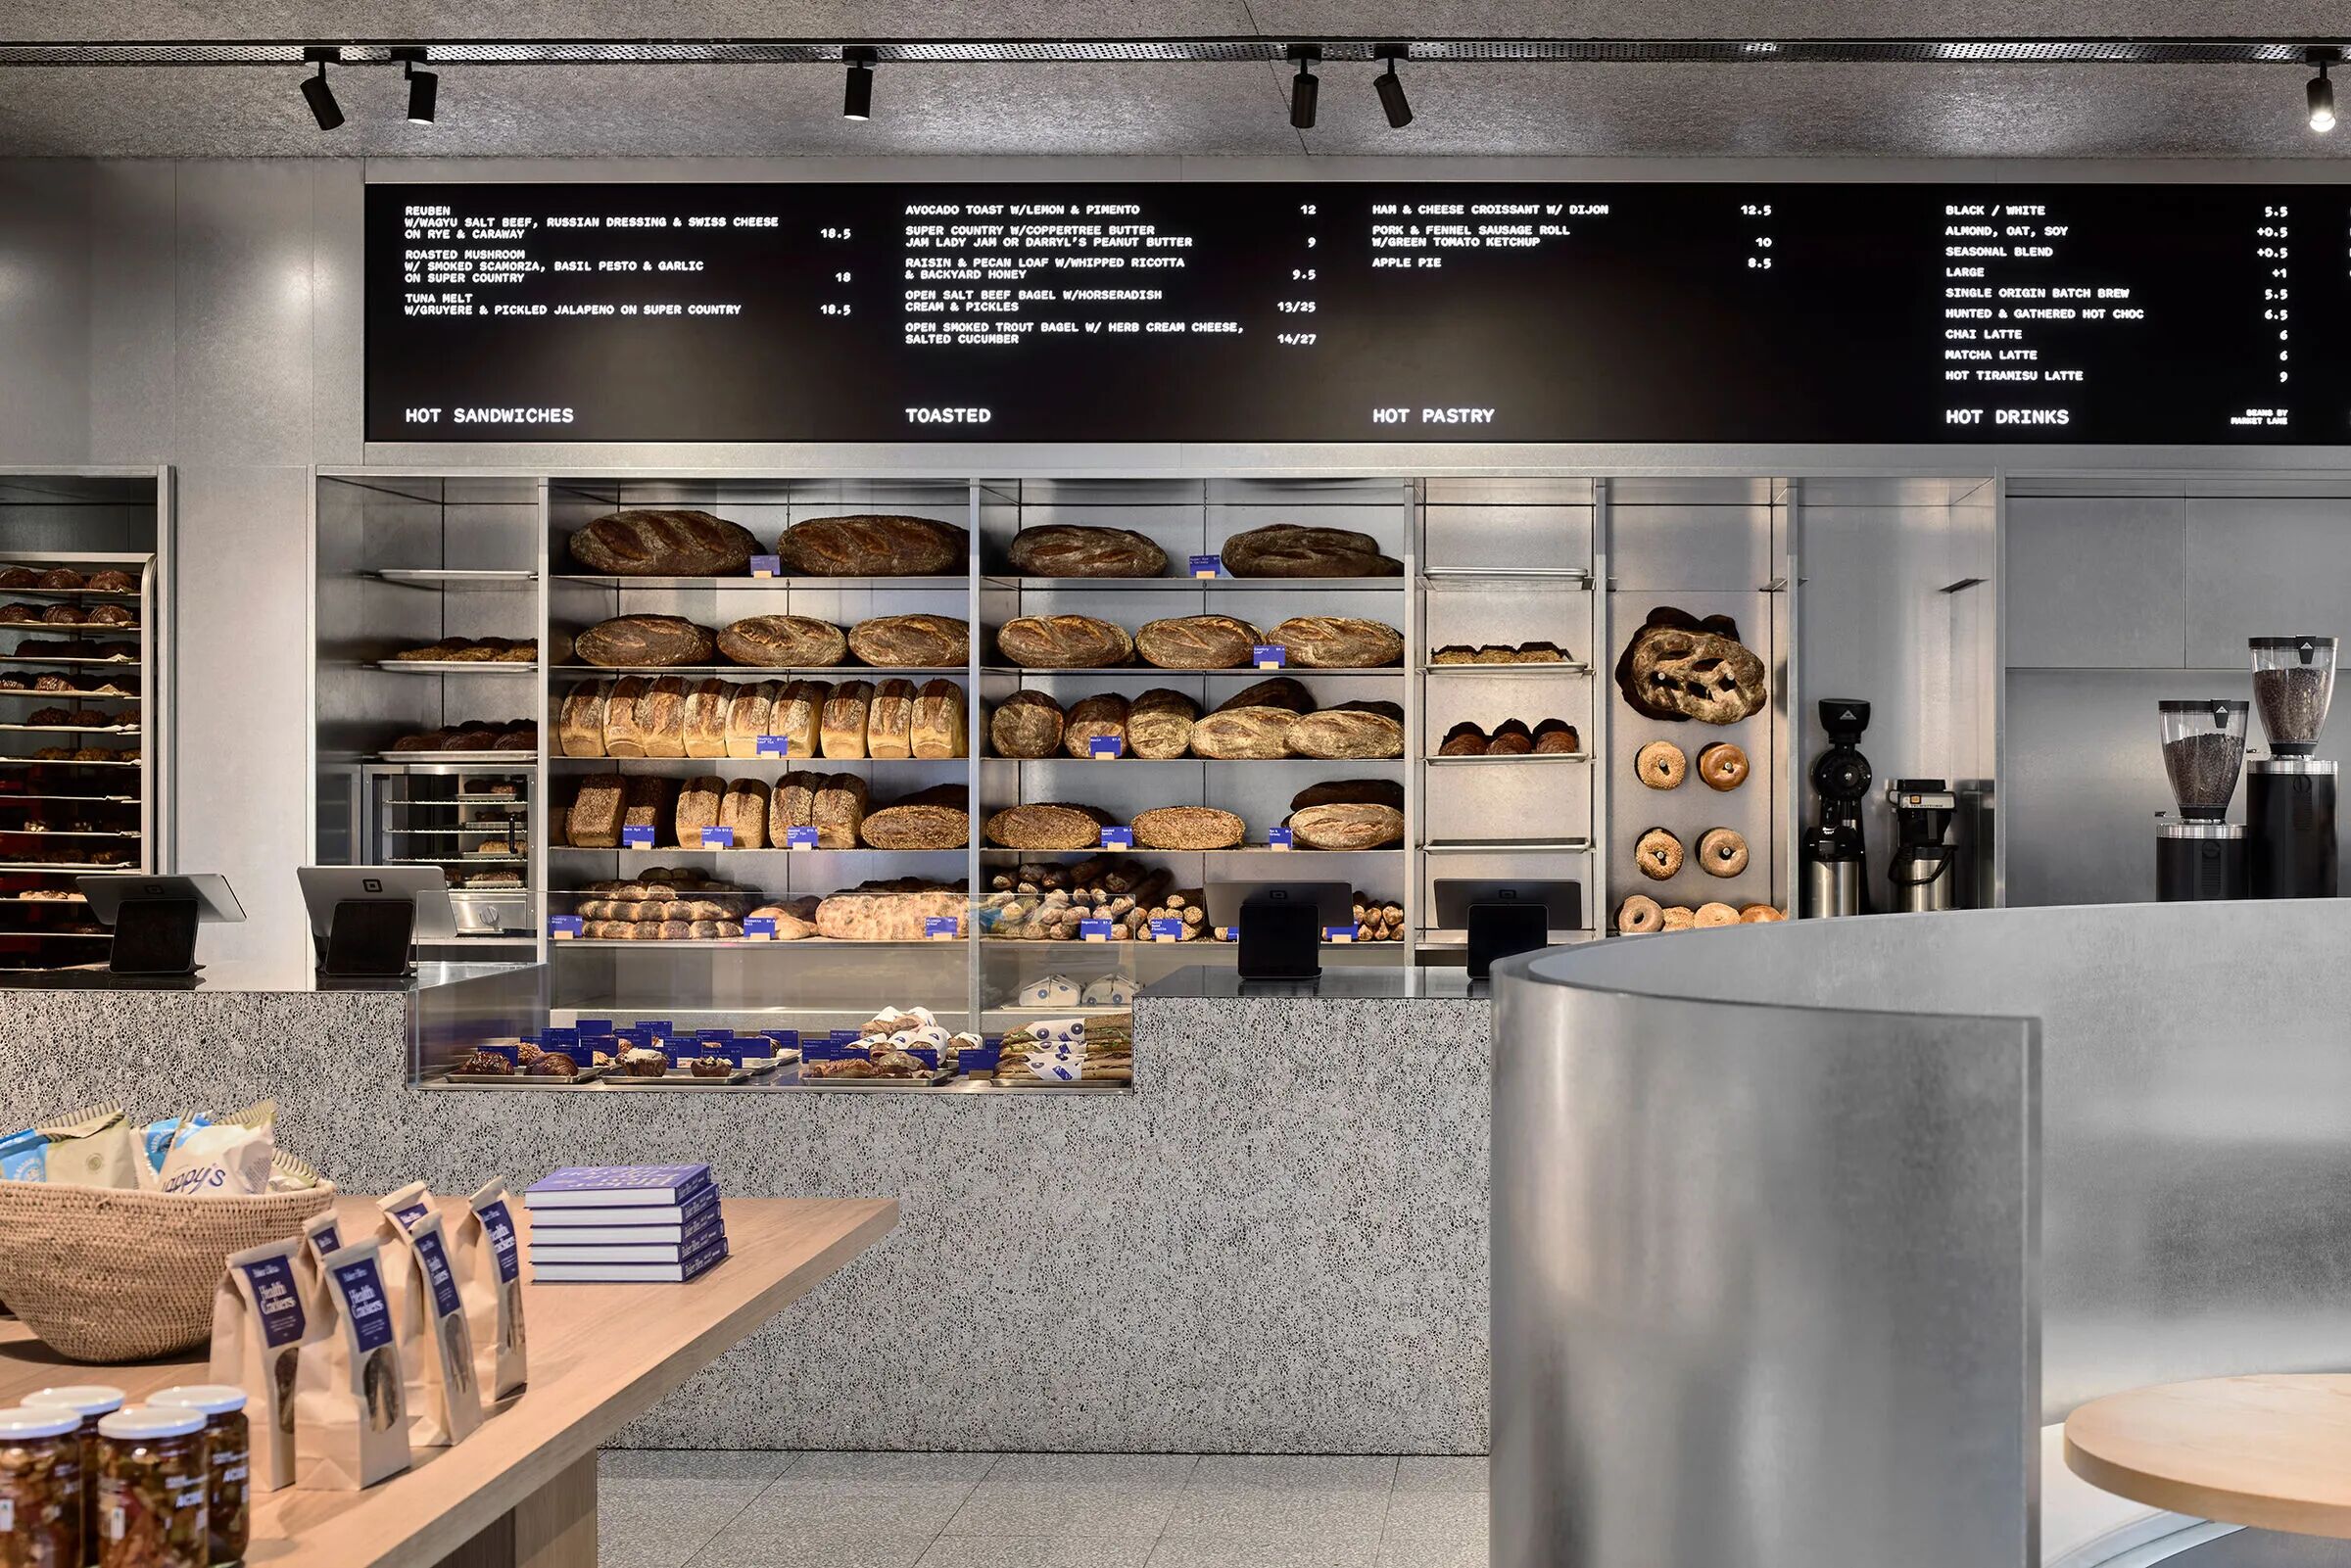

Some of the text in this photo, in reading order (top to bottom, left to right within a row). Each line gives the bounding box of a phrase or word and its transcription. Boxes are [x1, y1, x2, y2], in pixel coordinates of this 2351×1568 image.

[405, 205, 452, 216] REUBEN
[904, 204, 1141, 216] AVOCADO TOAST W/LEMON & PIMENTO
[1300, 204, 1317, 215] 12
[1371, 204, 1609, 216] HAM & CHEESE CROISSANT W/ DIJON
[1740, 205, 1772, 216] 12.5
[1945, 204, 2046, 217] BLACK / WHITE
[2264, 206, 2288, 218] 5.5
[404, 216, 779, 229] W/WAGYU SALT BEEF, RUSSIAN DRESSING & SWISS CHEESE
[404, 228, 525, 240] ON RYE & CARAWAY
[820, 227, 851, 240] 18.5
[905, 224, 1156, 238] SUPER COUNTRY W/COPPERTREE BUTTER
[1371, 224, 1571, 236] PORK & FENNEL SAUSAGE ROLL
[1944, 225, 2069, 238] ALMOND, OAT, SOY
[2256, 226, 2288, 239] +0.5
[905, 236, 1193, 248] JAM LADY JAM OR DARRYL'S PEANUT BUTTER
[1307, 236, 1317, 248] 9
[1370, 236, 1541, 249] W/GREEN TOMATO KETCHUP
[1754, 237, 1773, 248] 10
[405, 249, 526, 261] ROASTED MUSHROOM
[1944, 246, 2054, 258] SEASONAL BLEND
[2256, 247, 2288, 260] +0.5
[404, 260, 704, 273] W/ SMOKED SCAMORZA, BASIL PESTO & GARLIC
[905, 257, 1185, 269] RAISIN & PECAN LOAF W/WHIPPED RICOTTA
[1371, 257, 1442, 268] APPLE PIE
[1748, 257, 1772, 269] 8.5
[404, 272, 525, 284] ON SUPER COUNTRY
[835, 271, 851, 283] 18
[904, 268, 1028, 280] & BACKYARD HONEY
[1292, 268, 1317, 281] 9.5
[1945, 266, 1985, 278] LARGE
[2272, 267, 2287, 279] +1
[405, 293, 474, 305] TUNA MELT
[904, 289, 1163, 302] OPEN SALT BEEF BAGEL W/HORSERADISH
[1944, 287, 2131, 299] SINGLE ORIGIN BATCH BREW
[2264, 288, 2288, 301] 5.5
[404, 304, 743, 317] W/GRUYERE & PICKLED JALAPENO ON SUPER COUNTRY
[820, 304, 851, 316] 18.5
[904, 301, 1020, 312] CREAM & PICKLES
[1276, 301, 1317, 313] 13/25
[1944, 308, 2144, 320] HUNTED & GATHERED HOT CHOC
[2264, 309, 2288, 321] 6.5
[904, 321, 1244, 334] OPEN SMOKED TROUT BAGEL W/ HERB CREAM CHEESE,
[905, 333, 1020, 345] SALTED CUCUMBER
[1276, 333, 1318, 346] 14/27
[1944, 328, 2023, 340] CHAI LATTE
[2279, 329, 2288, 341] 6
[1944, 349, 2039, 360] MATCHA LATTE
[2279, 350, 2288, 361] 6
[1944, 369, 2084, 382] HOT TIRAMISU LATTE
[2279, 370, 2288, 383] 9
[406, 407, 575, 424] HOT SANDWICHES
[904, 406, 991, 424] TOASTED
[1372, 407, 1496, 424] HOT PASTRY
[1945, 408, 2070, 425] HOT DRINKS
[163, 1167, 226, 1195] appy's
